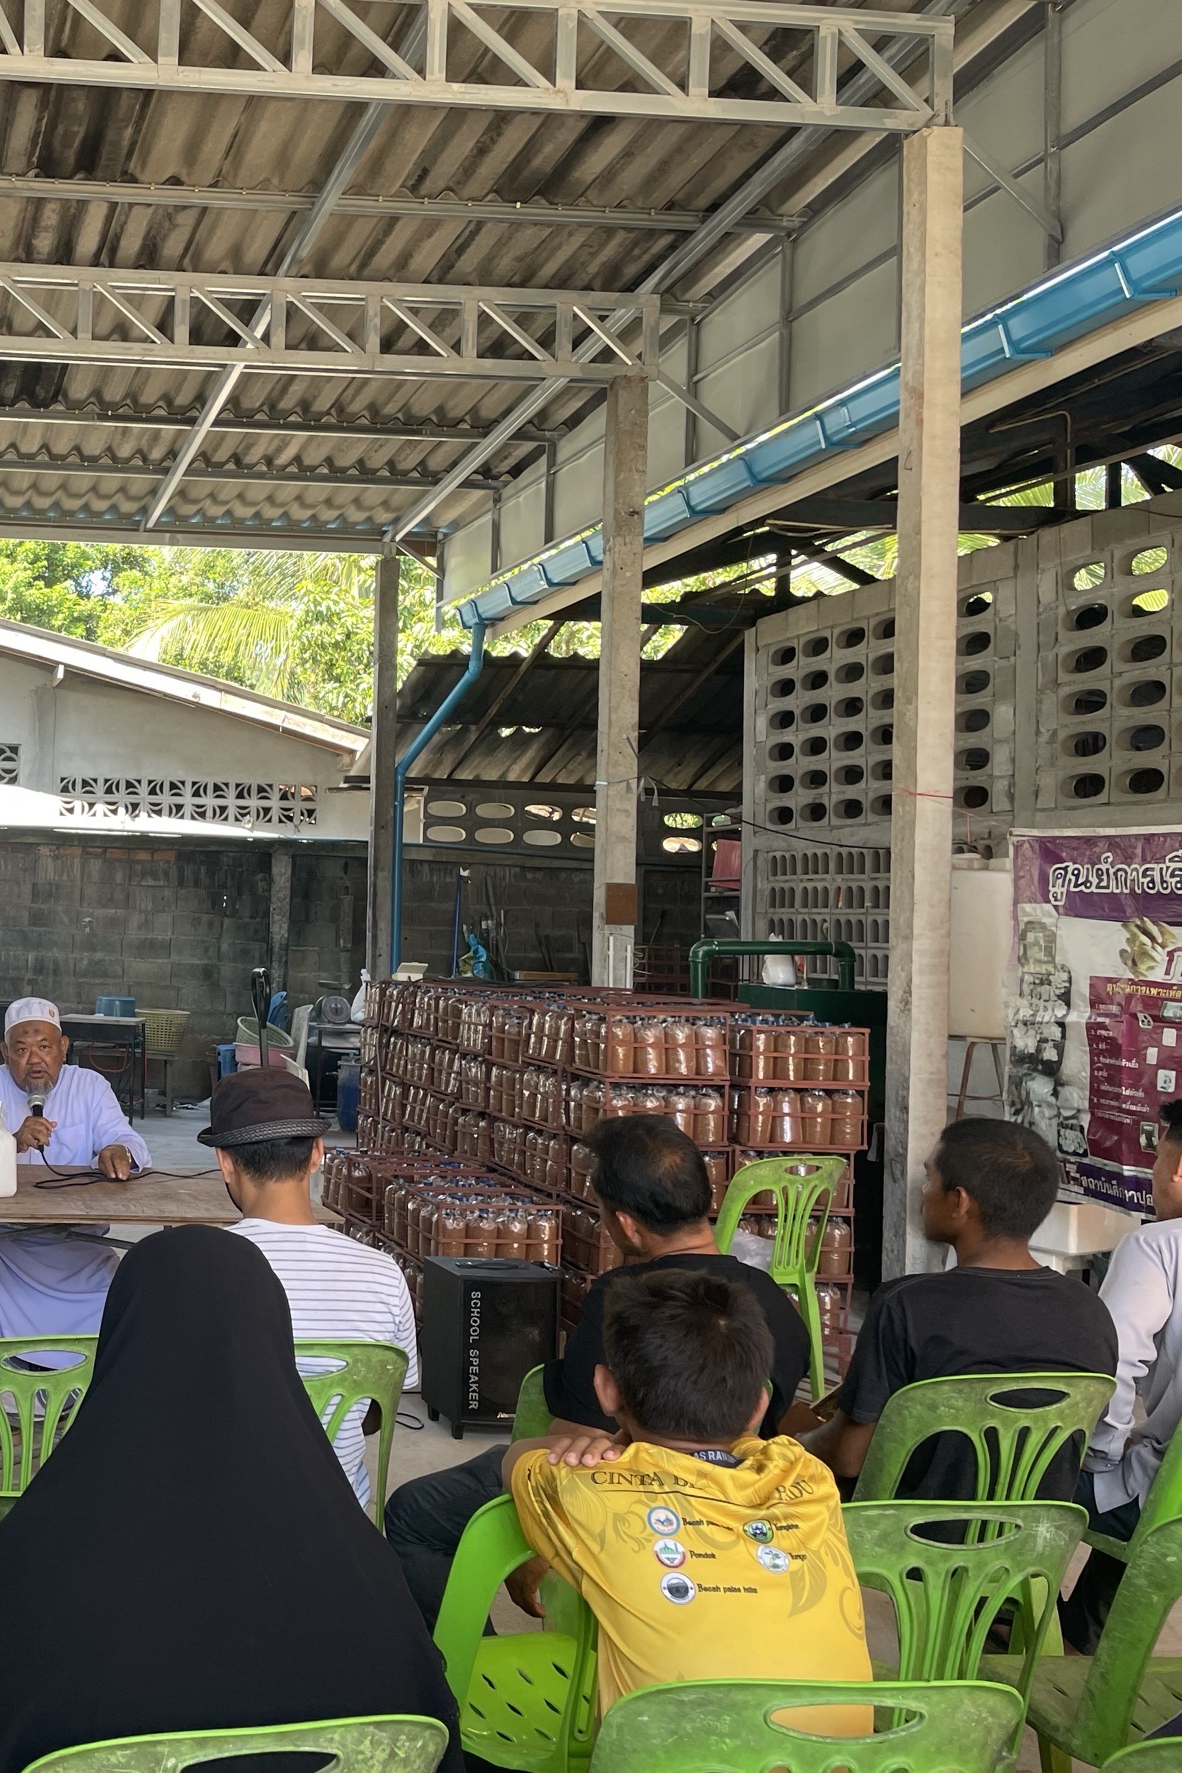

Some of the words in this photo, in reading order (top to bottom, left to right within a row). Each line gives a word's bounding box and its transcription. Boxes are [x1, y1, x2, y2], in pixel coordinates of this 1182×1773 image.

[469, 1290, 482, 1344] SCHOOL
[468, 1349, 480, 1410] SPEAKER
[590, 1470, 665, 1487] CINTA
